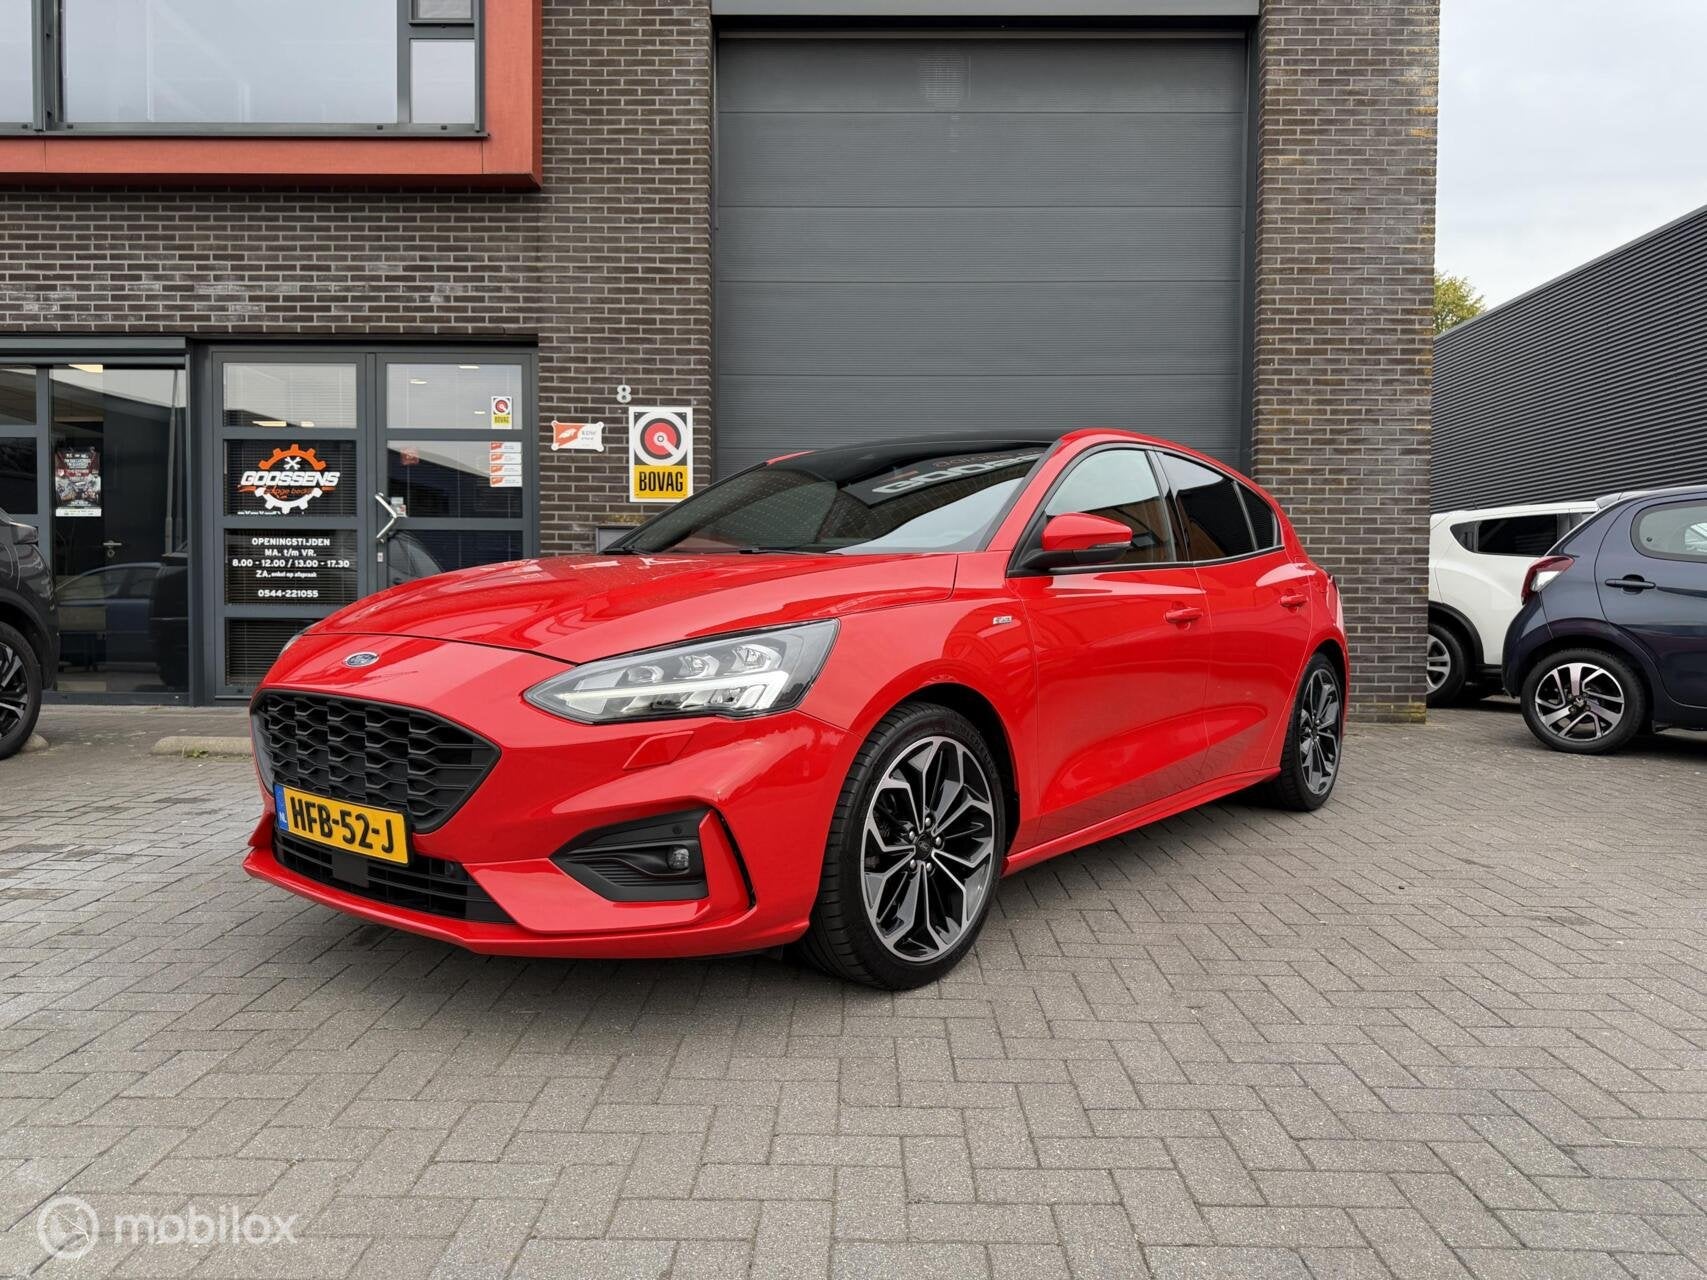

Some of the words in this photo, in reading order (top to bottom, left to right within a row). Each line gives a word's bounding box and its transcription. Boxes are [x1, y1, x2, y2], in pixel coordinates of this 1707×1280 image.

[616, 384, 632, 403] 8
[240, 471, 340, 486] GOOSSENS
[638, 471, 683, 492] BOVAG
[251, 537, 330, 546] OPENINGSTIJDEN
[264, 548, 281, 556] MA.
[283, 548, 299, 557] t/m
[301, 549, 316, 557] VR.
[232, 559, 253, 567] 8.00
[261, 559, 286, 567] 12.00
[294, 559, 319, 568] 13.00
[326, 560, 350, 568] 17.30
[255, 569, 271, 578] ZA.
[257, 589, 319, 598] 0544-221055
[289, 796, 394, 854] HFB-52-J
